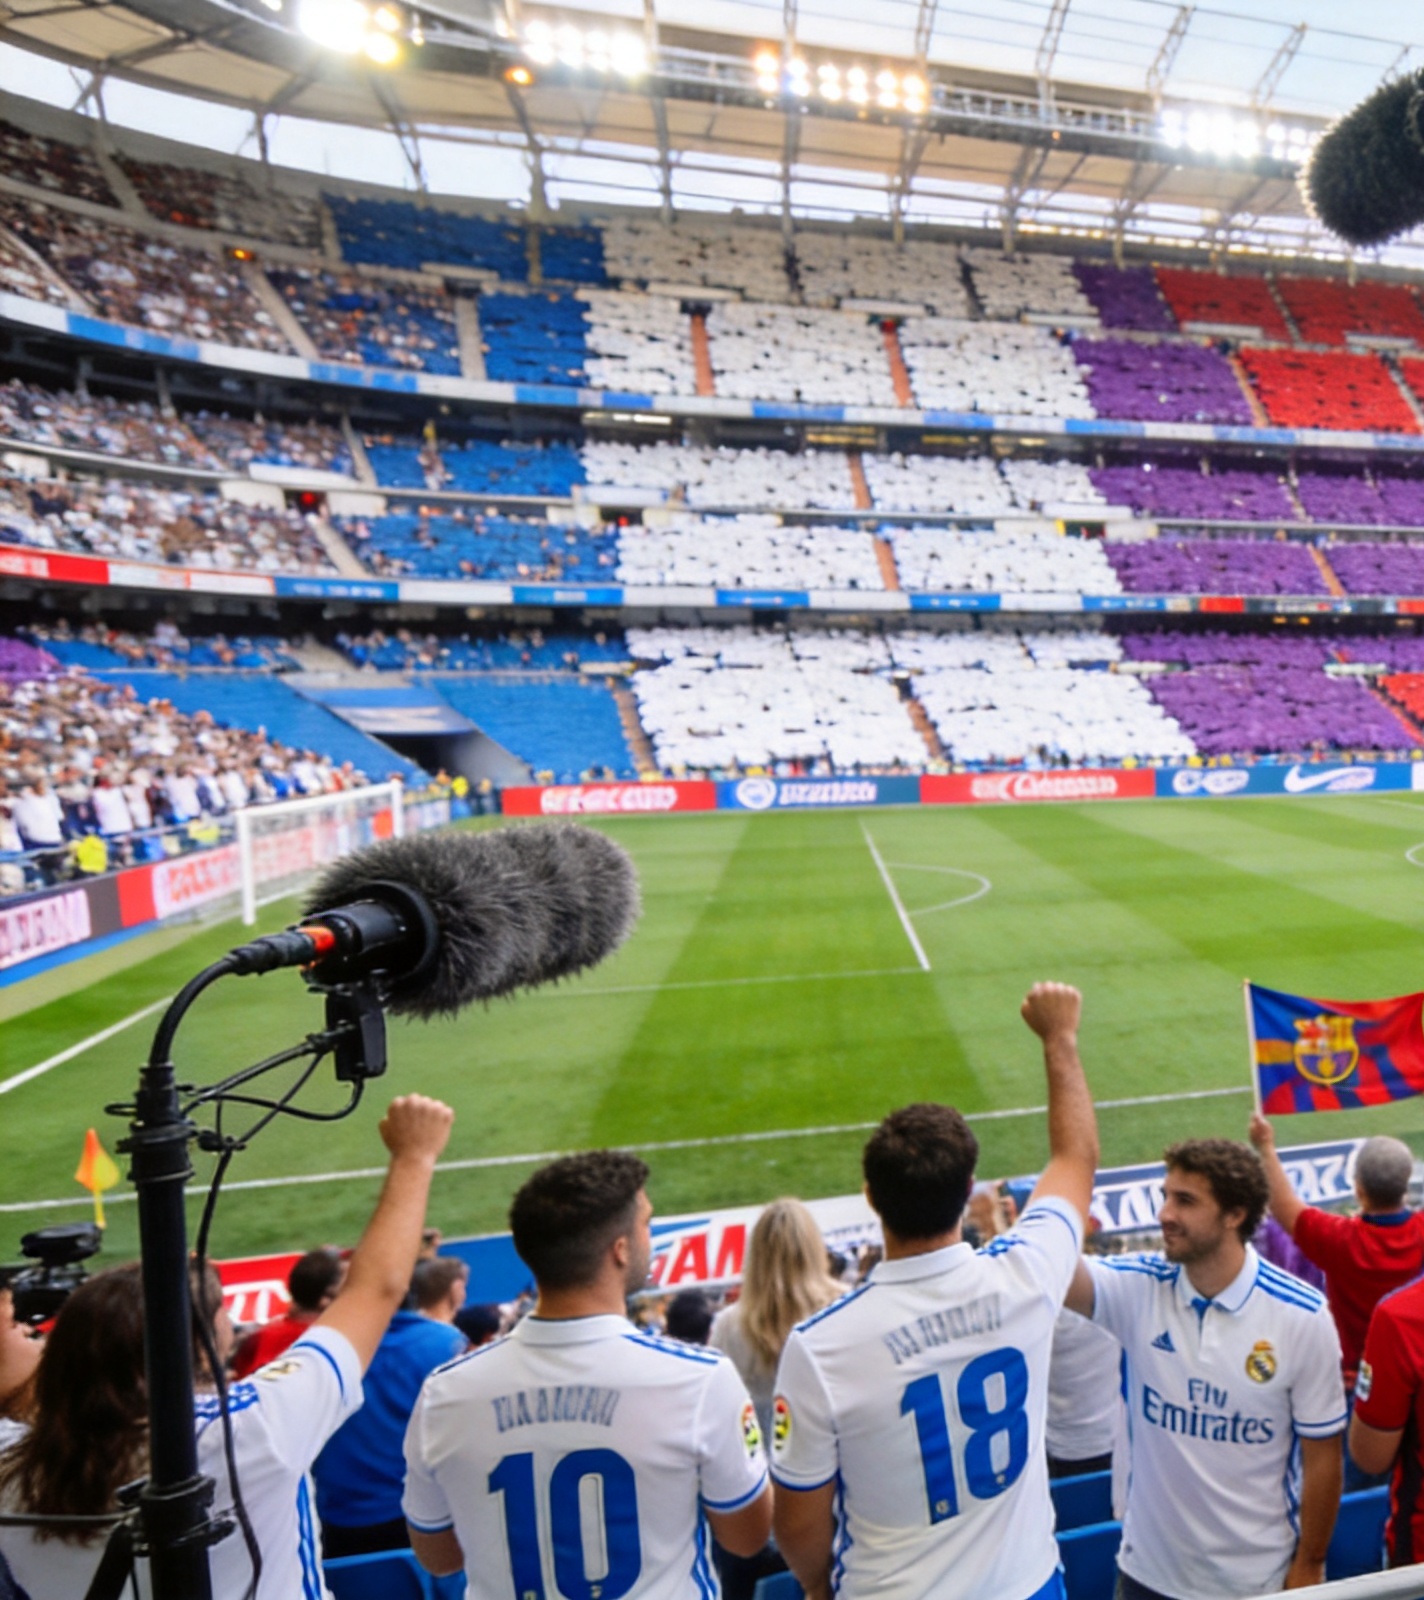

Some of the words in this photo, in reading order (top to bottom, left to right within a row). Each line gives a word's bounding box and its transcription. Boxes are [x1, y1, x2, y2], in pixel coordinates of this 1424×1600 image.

[900, 1346, 1029, 1526] 18
[1142, 1383, 1274, 1444] Emirates
[488, 1447, 642, 1600] 10
